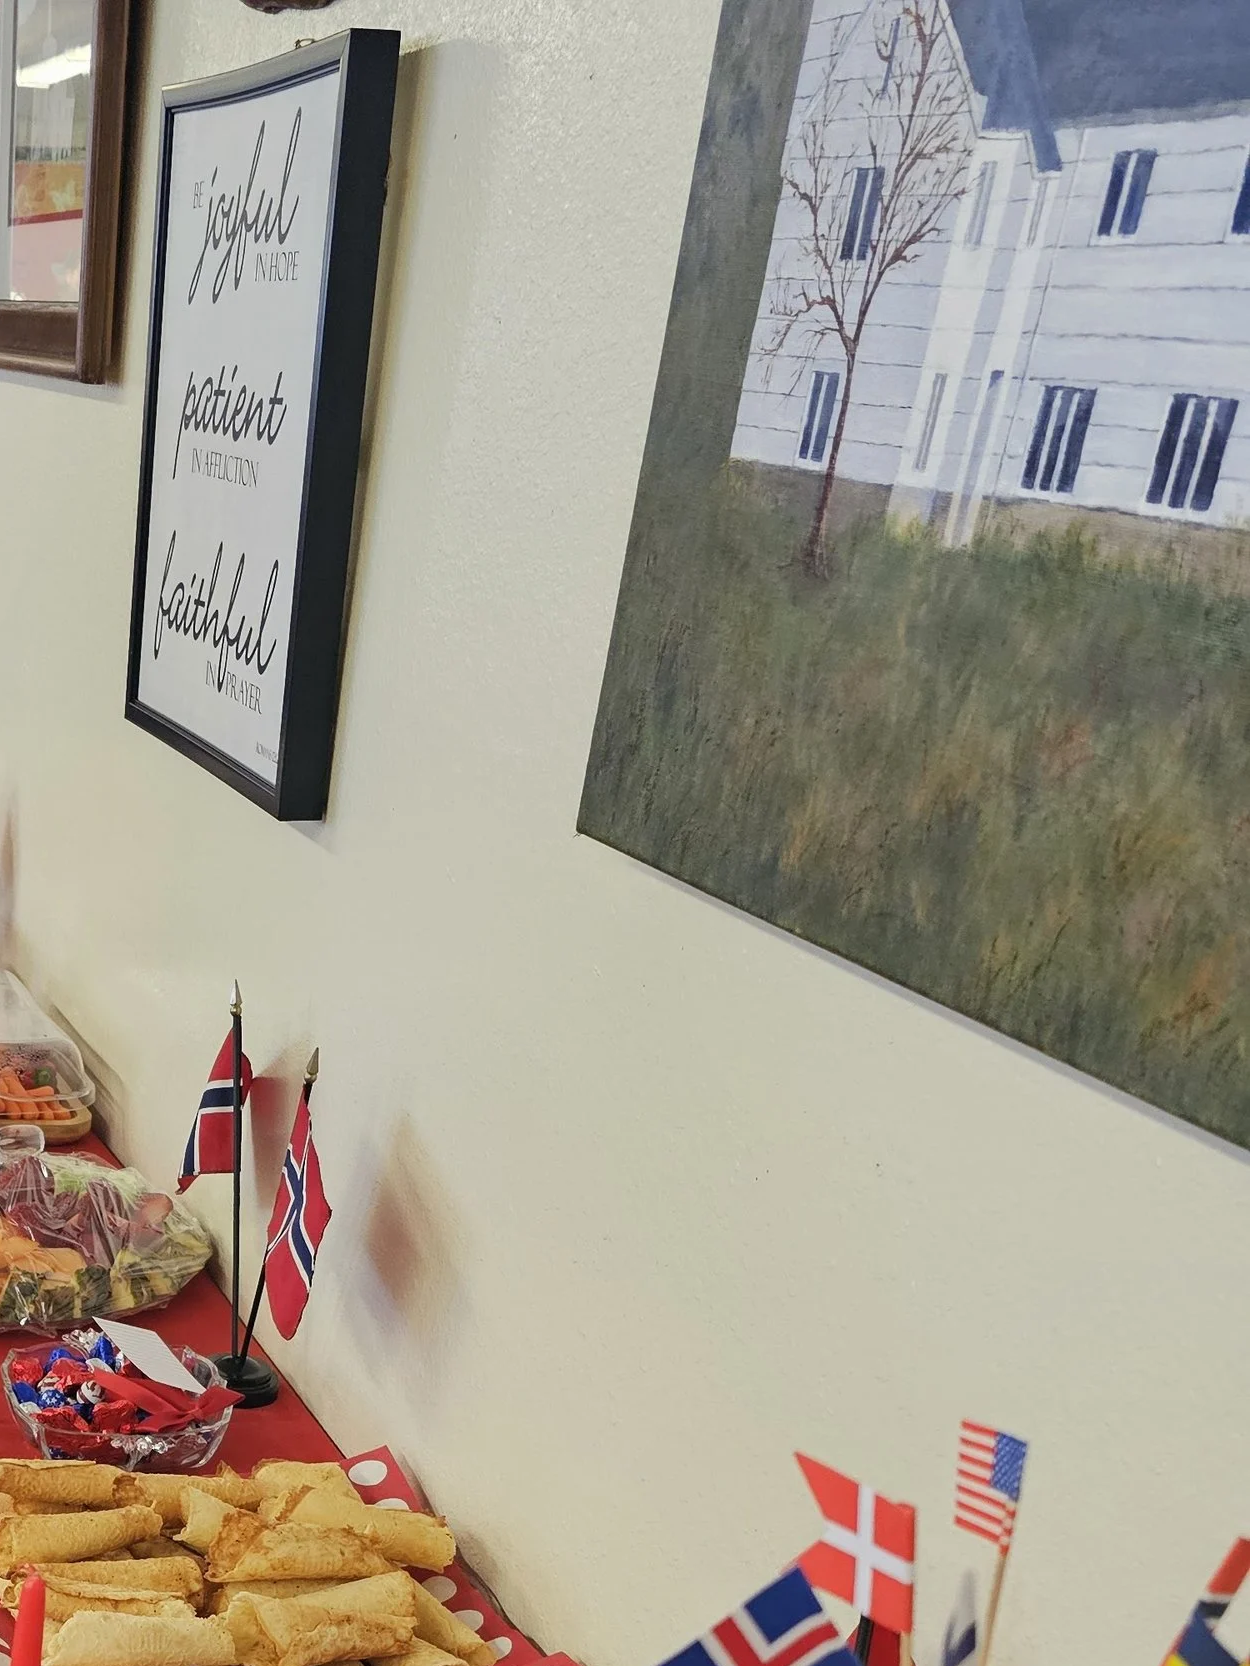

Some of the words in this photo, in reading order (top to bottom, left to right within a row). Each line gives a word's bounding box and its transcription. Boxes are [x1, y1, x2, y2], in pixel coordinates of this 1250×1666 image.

[187, 106, 302, 305] joyful
[193, 181, 205, 209] BE
[254, 253, 269, 282] IN
[269, 251, 301, 282] HOPE
[172, 364, 287, 480] patient
[191, 448, 202, 474] IN
[203, 451, 259, 489] AFFLICTION
[153, 529, 279, 693] faithful
[205, 660, 216, 686] IN
[225, 671, 262, 715] PRAYER
